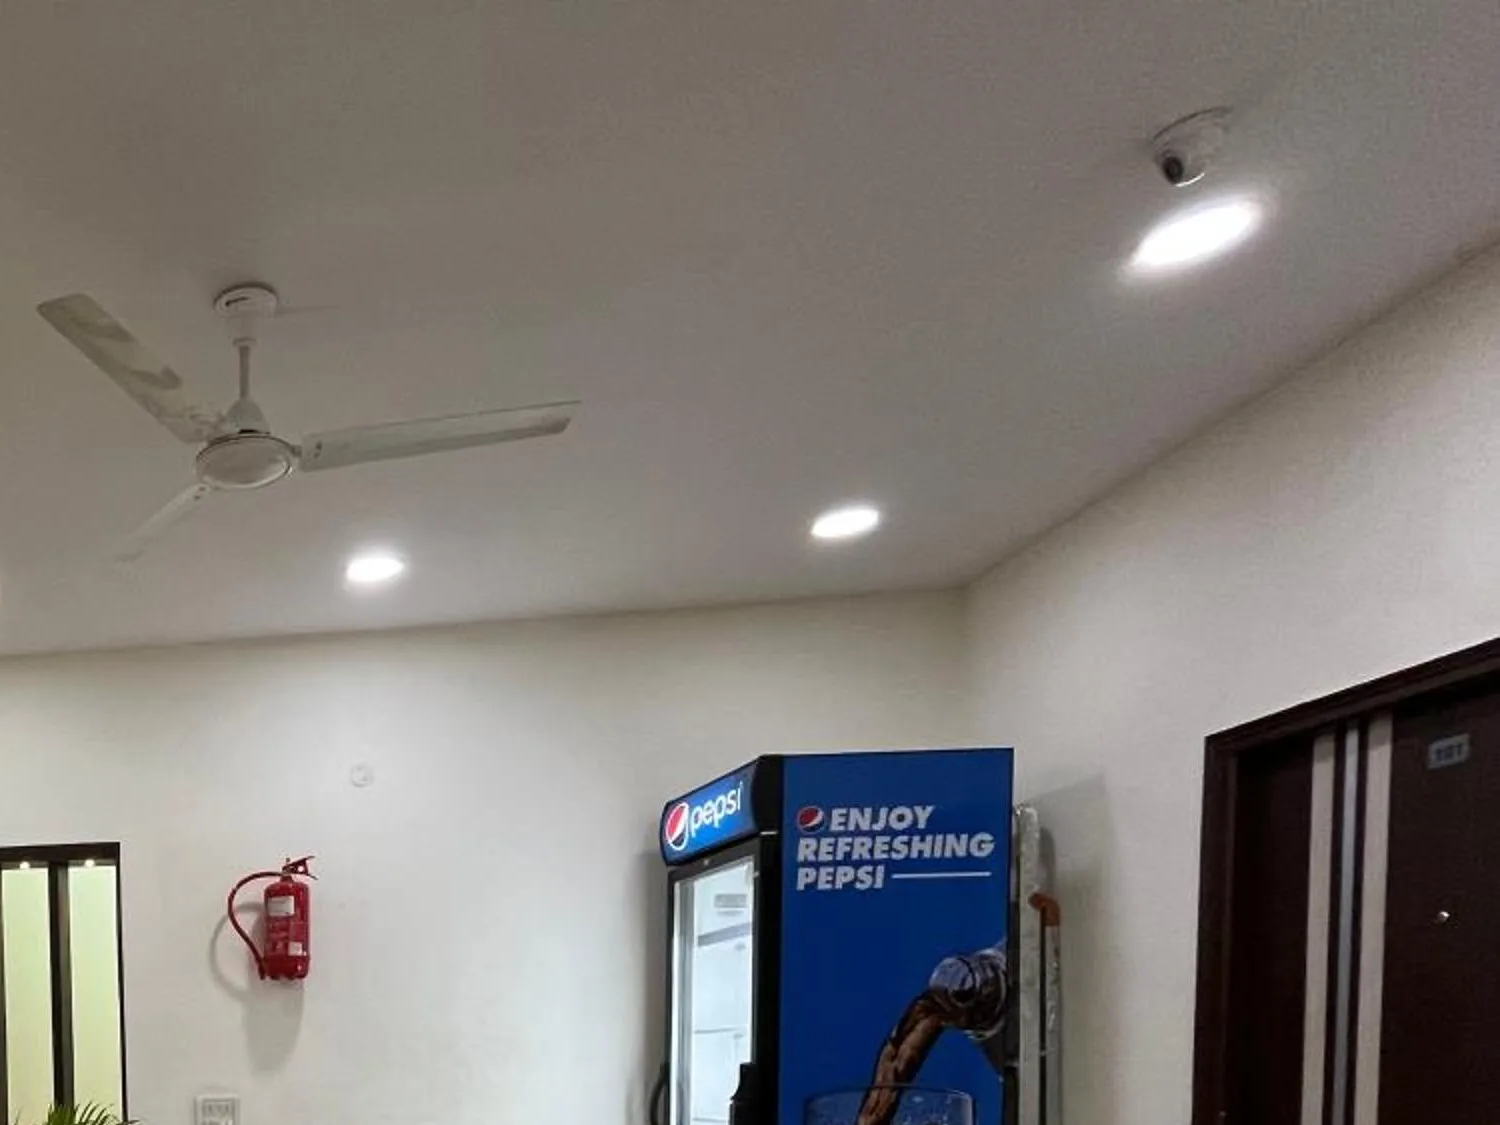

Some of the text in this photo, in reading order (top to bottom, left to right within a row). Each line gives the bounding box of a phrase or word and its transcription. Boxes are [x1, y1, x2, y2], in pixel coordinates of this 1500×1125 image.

[691, 781, 742, 838] pepsi
[829, 805, 935, 832] ENJOY
[797, 832, 996, 862] REFRESHING
[796, 864, 886, 891] PEPSI
